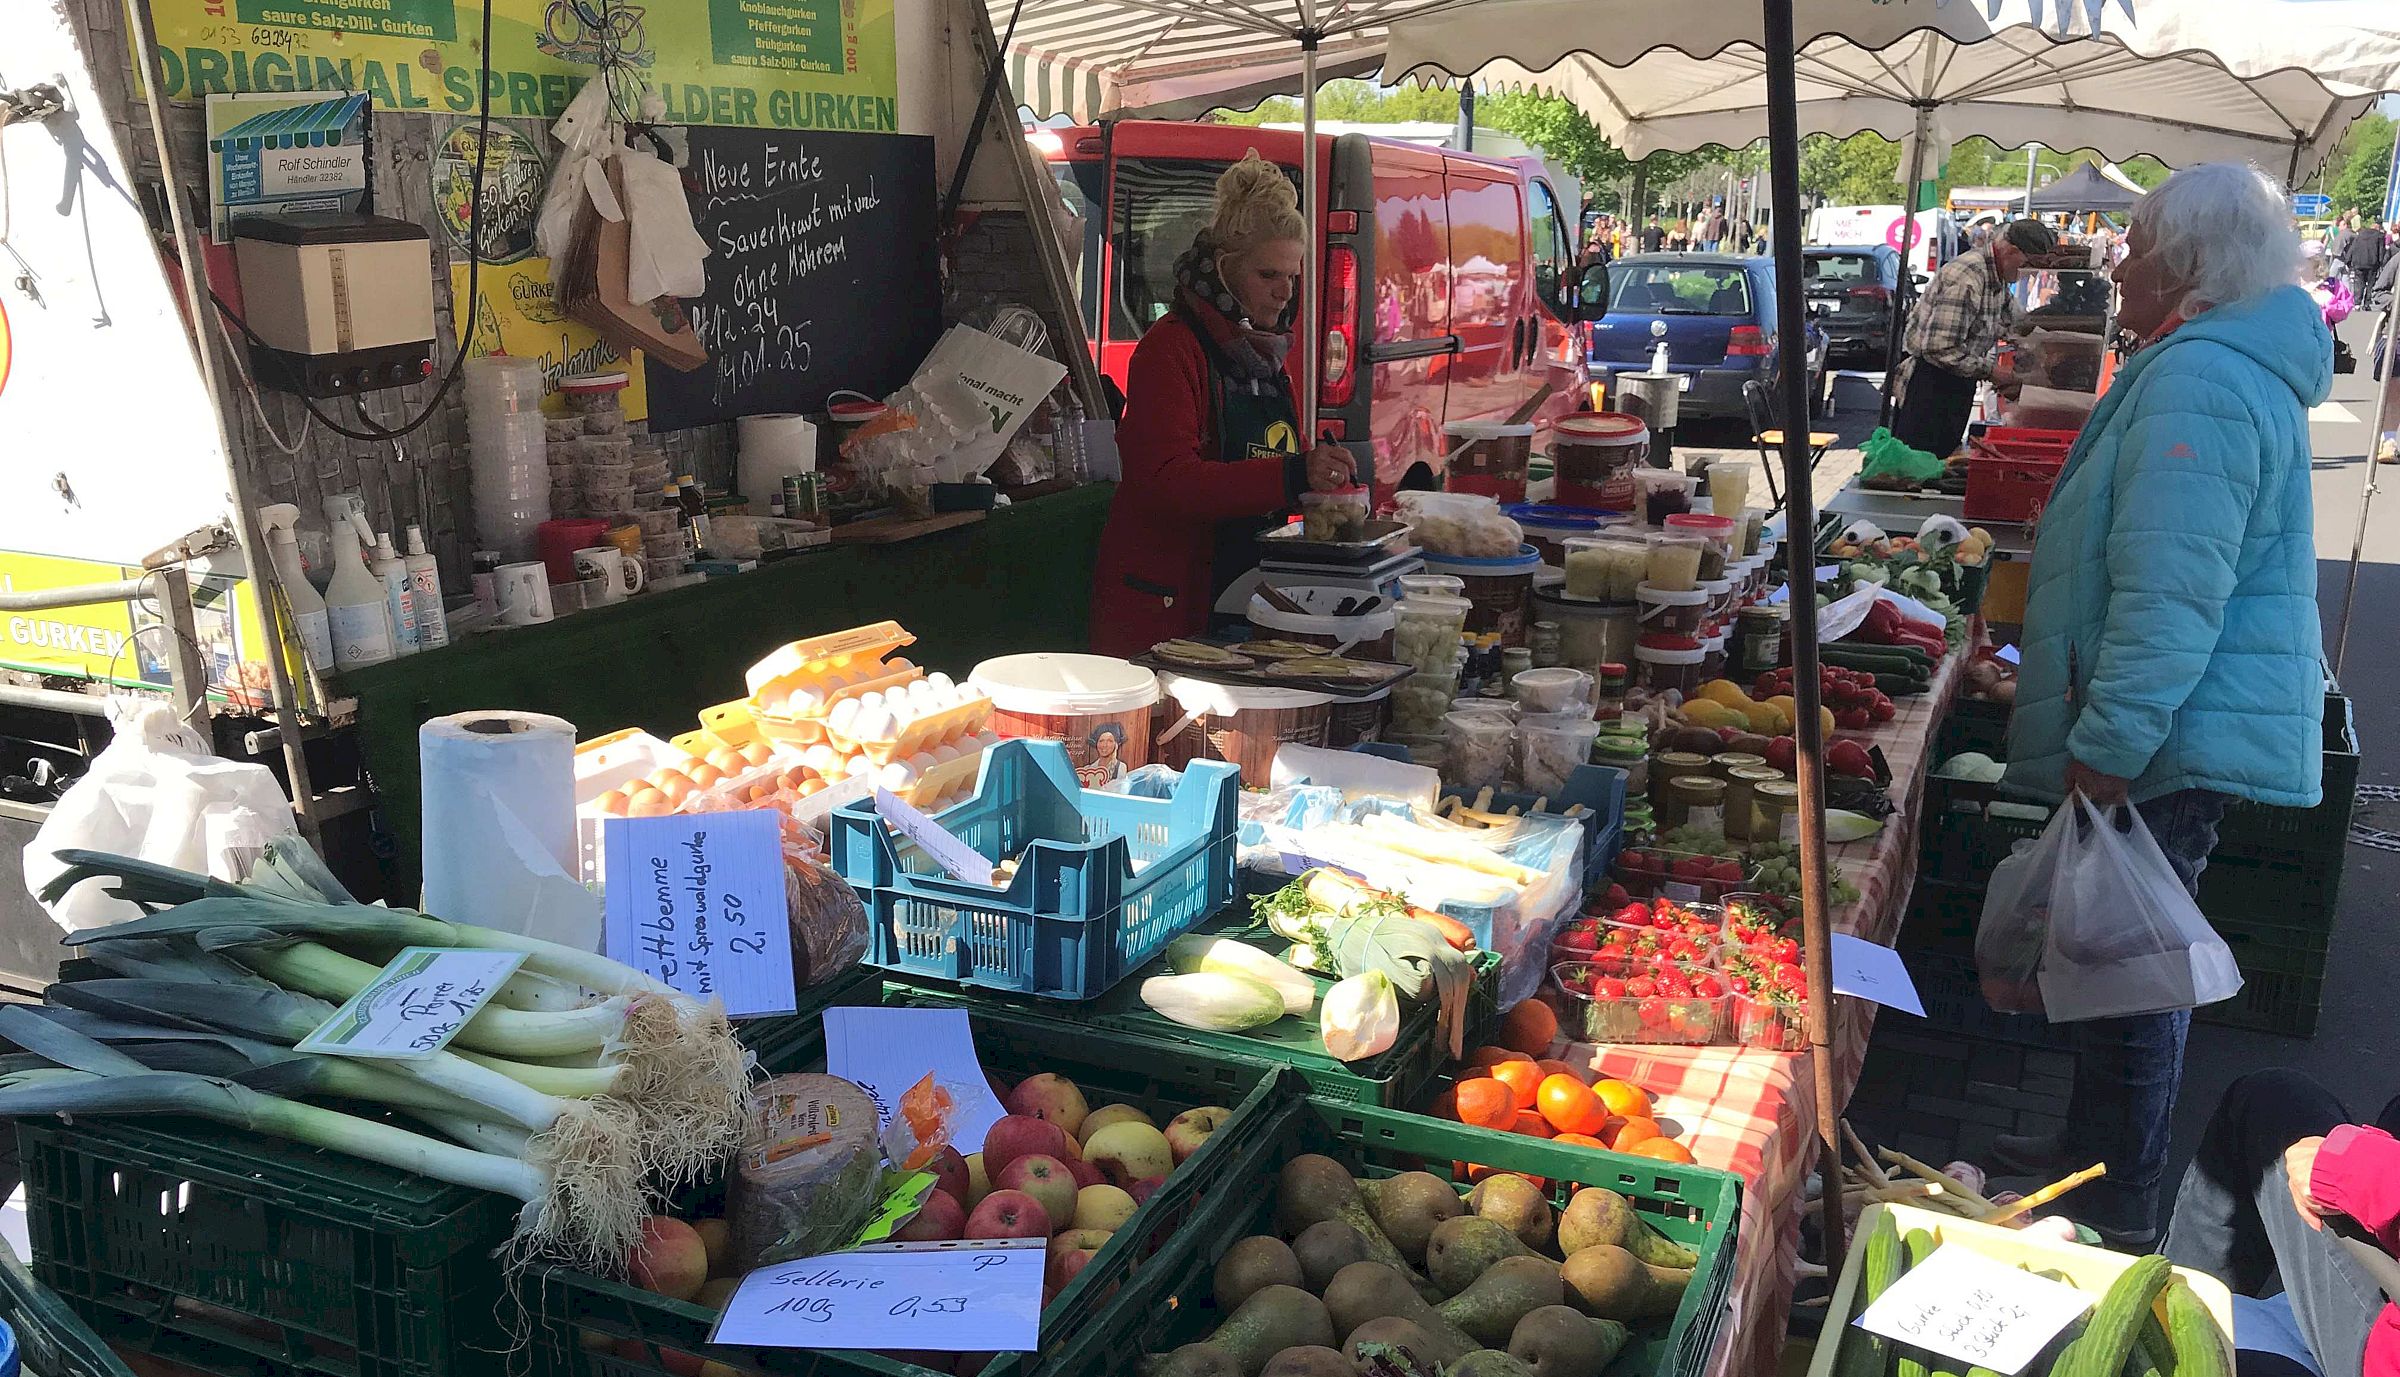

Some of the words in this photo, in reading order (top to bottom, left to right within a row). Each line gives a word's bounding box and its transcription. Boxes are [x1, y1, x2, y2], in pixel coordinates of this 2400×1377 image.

[262, 9, 307, 25] saure
[381, 20, 435, 37] Gurken
[740, 1, 817, 20] Knoblauchgurken
[748, 18, 812, 37] Pfeffergurken
[755, 37, 807, 53] Brühgurken
[730, 54, 758, 66] saure
[800, 58, 831, 72] Gurken
[846, 48, 858, 73] 100
[139, 45, 429, 109] ORIGINAL
[443, 66, 760, 127] SPRELDER
[769, 89, 896, 132] GURKEN
[278, 159, 300, 172] Rolf
[303, 156, 352, 170] Schindler
[703, 148, 750, 194] Neue
[764, 142, 823, 188] Ernte
[287, 174, 318, 185] Händler
[480, 186, 498, 213] 30
[829, 184, 852, 223] mit
[854, 174, 881, 214] und
[480, 204, 519, 255] Gurken
[512, 282, 556, 300] GURKE
[985, 385, 1025, 407] macht
[9, 616, 127, 660] GURKEN
[686, 960, 713, 994] mit
[769, 1269, 885, 1290] Sellerie
[764, 1296, 837, 1323] 100g
